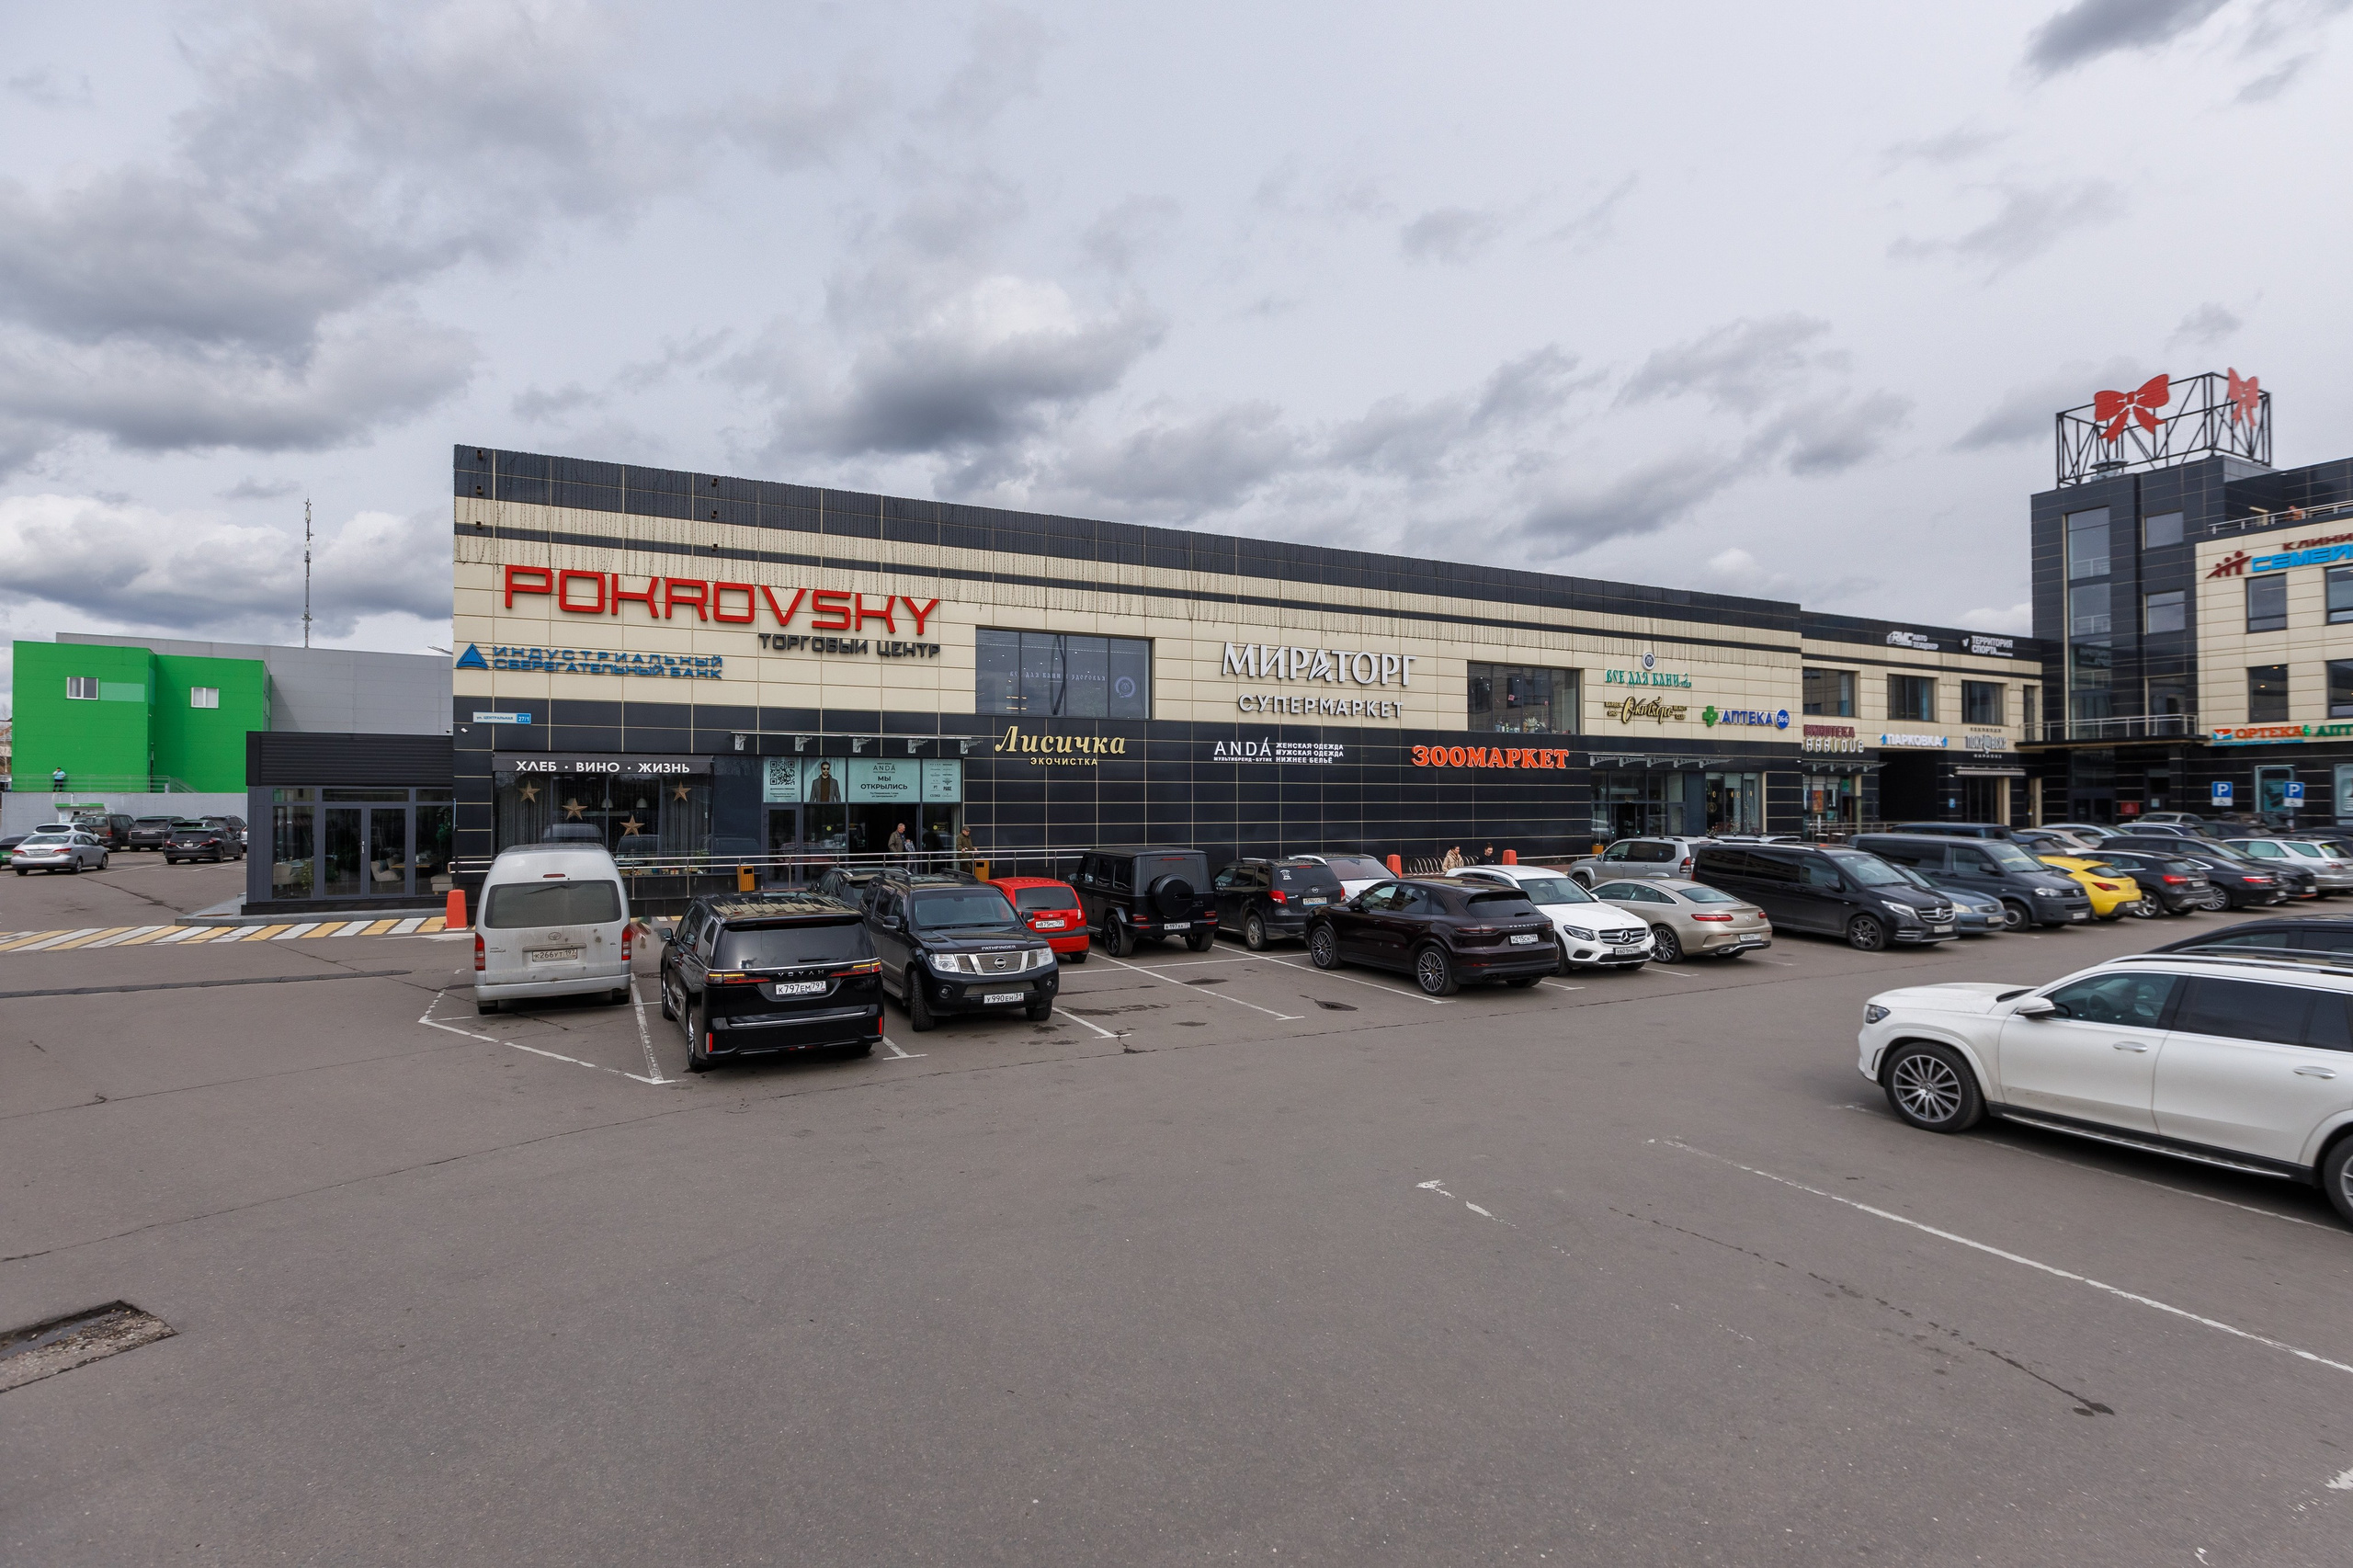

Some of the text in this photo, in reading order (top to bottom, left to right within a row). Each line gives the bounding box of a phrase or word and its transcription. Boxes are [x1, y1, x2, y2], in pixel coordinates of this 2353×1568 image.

[505, 564, 940, 636] POKROVSKY
[1971, 635, 2013, 648] ТЕРРИТОРИЯ
[1971, 644, 1997, 653] СПОРТА
[494, 645, 723, 668] ИНДУСТРИАЛЬНЫЙ
[877, 641, 940, 658] ЦЕНТР
[494, 658, 722, 679] СБЕРЕГАТЕЛЬНЫЙ БАНК
[1222, 642, 1416, 686] МИРАТОРГ
[1605, 669, 1625, 683] ВСЕ
[1628, 671, 1648, 687] ДЛЯ
[1652, 673, 1678, 687] БАНИ
[1238, 694, 1404, 718] СУПЕРМАРКЕТ
[1722, 710, 1774, 725] АПТЕКА
[1803, 724, 1856, 738] ВИНОТЕКА
[2235, 726, 2304, 739] ОРТЕКА
[995, 725, 1127, 755] Лисичка
[1276, 742, 1312, 750] ЖЕНСКАЯ
[1887, 733, 1943, 747] ПАРКОВКА
[1030, 757, 1098, 766] ЭКОЧИСТКА
[1411, 745, 1570, 768] ЗООМАРКЕТ
[516, 761, 690, 773] ХЛЕБ ВИНО ЖИЗНЬ
[2217, 784, 2229, 796] P
[2289, 784, 2301, 797] P
